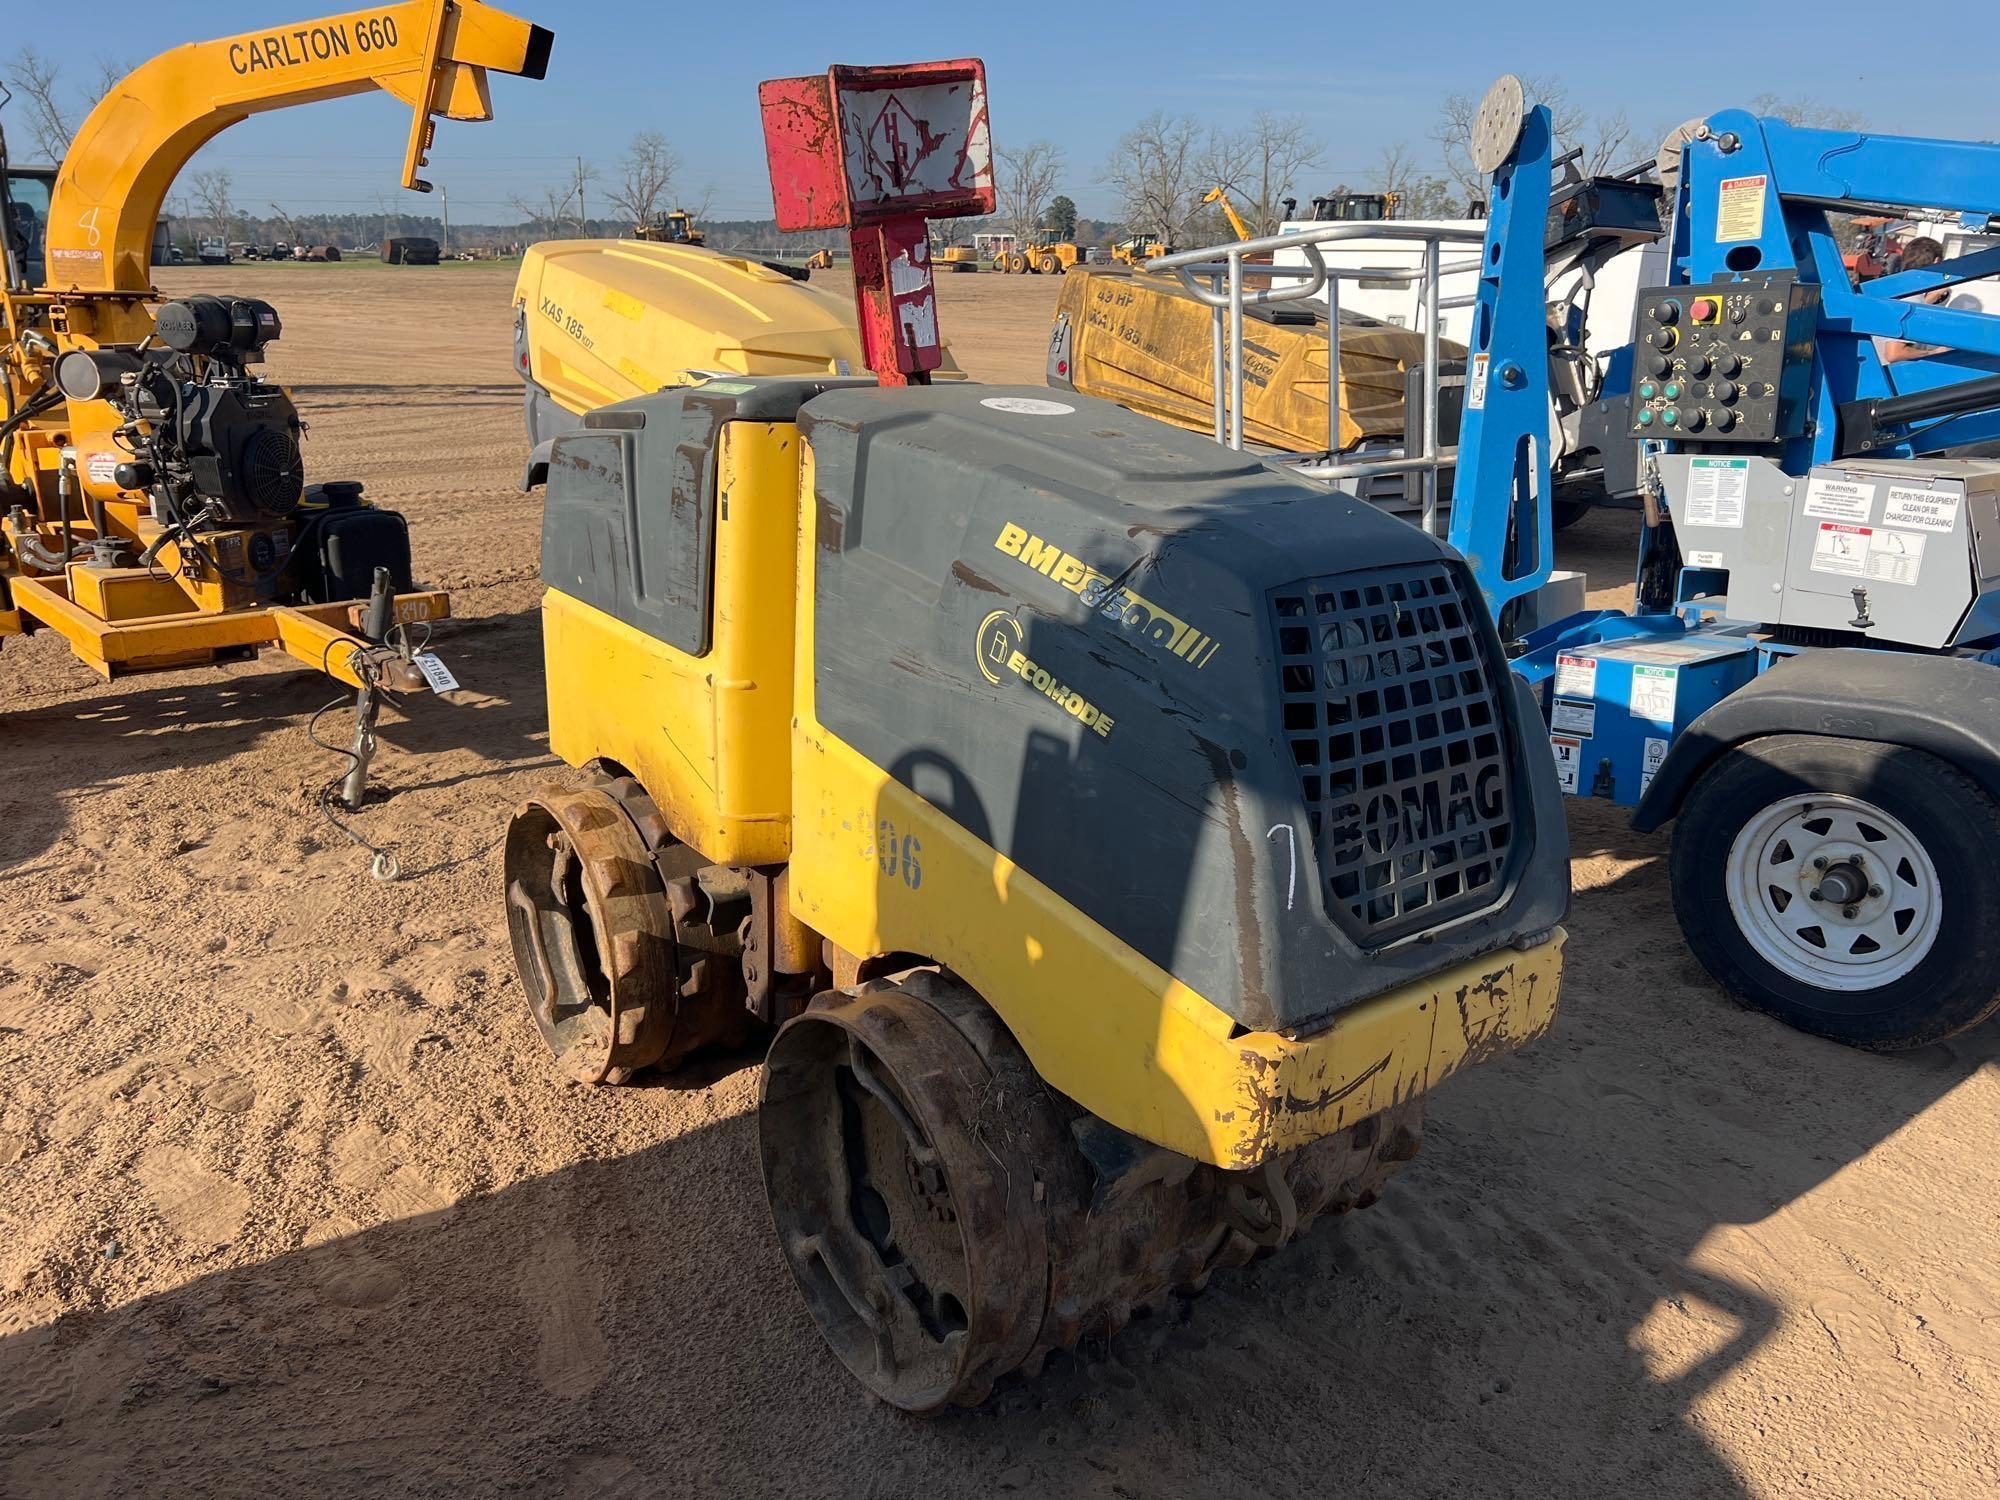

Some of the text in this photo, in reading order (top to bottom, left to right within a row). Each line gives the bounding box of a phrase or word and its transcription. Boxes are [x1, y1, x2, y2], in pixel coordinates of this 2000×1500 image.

[229, 15, 398, 75] CARLTON 660
[541, 295, 563, 324] XAS
[565, 315, 584, 340] 185
[159, 320, 194, 332] KOHLER
[1708, 460, 1732, 468] NOTICE
[1825, 483, 1858, 494] WARNING
[1890, 491, 1958, 505] RETURN THIS EQUIPMENT
[1902, 503, 1939, 515] CLEAN OR BE
[1885, 511, 1953, 528] CHARGED FOR CLEANING
[1006, 649, 1116, 738] ECOMODE
[1331, 763, 1504, 867] BOMAG
